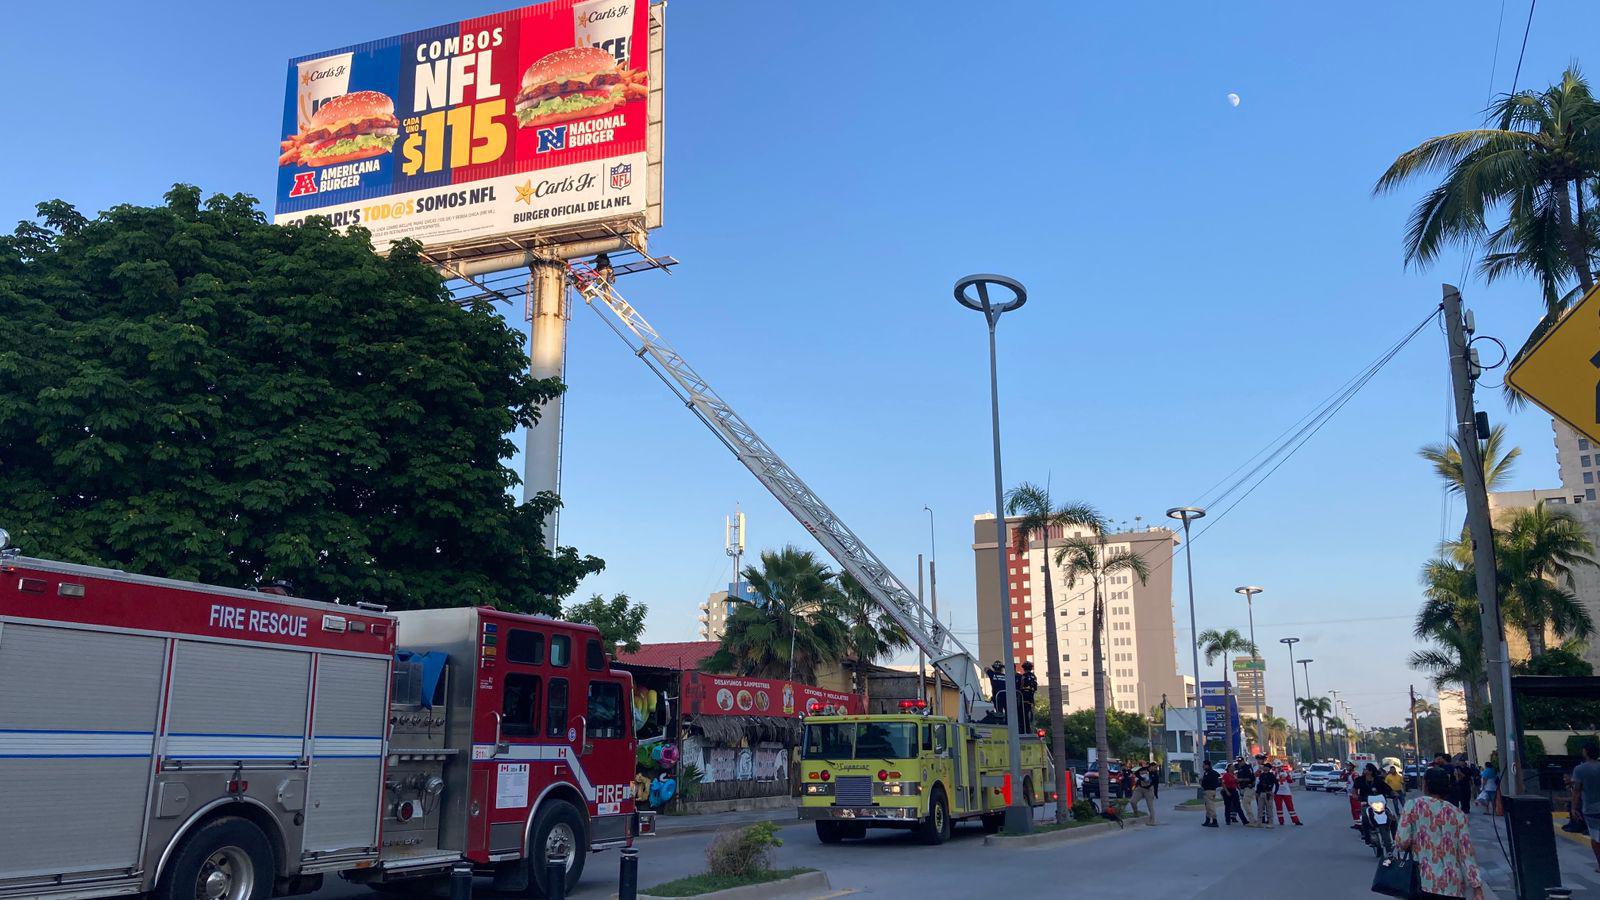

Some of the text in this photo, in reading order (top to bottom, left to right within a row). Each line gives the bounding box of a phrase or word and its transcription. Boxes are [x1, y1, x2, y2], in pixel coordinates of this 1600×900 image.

[417, 27, 503, 62] COMBOS
[413, 49, 501, 113] NFL
[402, 117, 419, 127] CADA
[405, 124, 419, 133] UNO
[569, 114, 626, 135] NACIONAL
[402, 98, 508, 176] $115
[568, 129, 614, 148] BURGER
[321, 159, 380, 181] AMERICANA
[612, 174, 630, 188] NFL
[319, 175, 360, 193] BURGER
[535, 173, 596, 198] Carl's Jr.
[317, 208, 361, 228] ARL'S
[363, 199, 414, 222] TOD@S
[416, 191, 467, 214] SOMOS
[469, 186, 497, 205] NFL
[513, 196, 632, 223] BURGER OFICIAL DE LA NFL
[209, 604, 308, 637] FIRE RESCUE
[595, 784, 623, 804] FIRE
